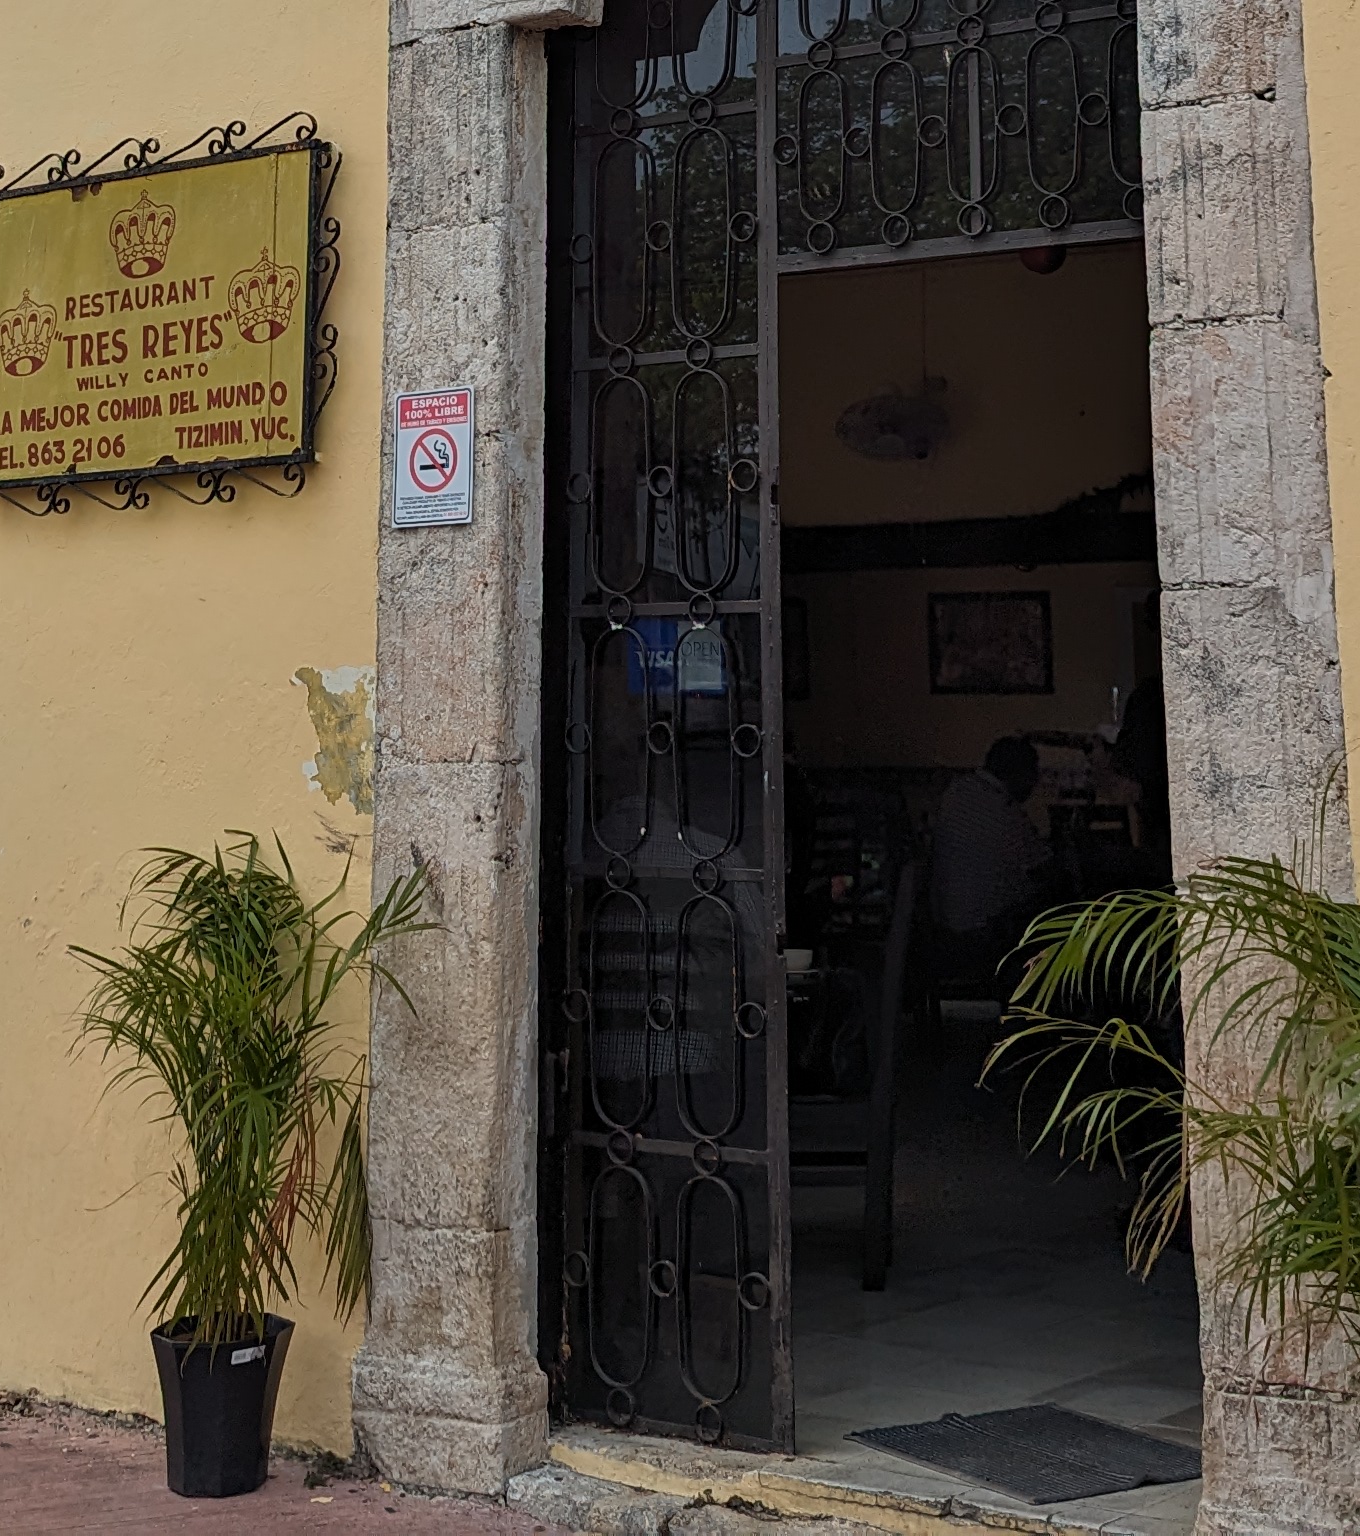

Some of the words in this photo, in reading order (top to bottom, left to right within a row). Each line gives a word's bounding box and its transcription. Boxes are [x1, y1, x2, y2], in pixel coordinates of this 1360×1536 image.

[65, 275, 215, 321] RESTAURANT
[54, 328, 128, 369] "TRES
[142, 310, 232, 359] REYES"
[76, 373, 129, 391] WILLY
[144, 362, 209, 383] CANTO
[20, 403, 90, 432] MEJOR
[97, 394, 162, 422] COMIDA
[169, 390, 199, 415] DEL
[405, 409, 432, 419] 100%
[435, 405, 464, 416] LIBRE
[412, 396, 457, 408] ESPACIO
[250, 416, 296, 443] YUC.
[28, 439, 65, 468] 863
[681, 641, 720, 657] OPEN
